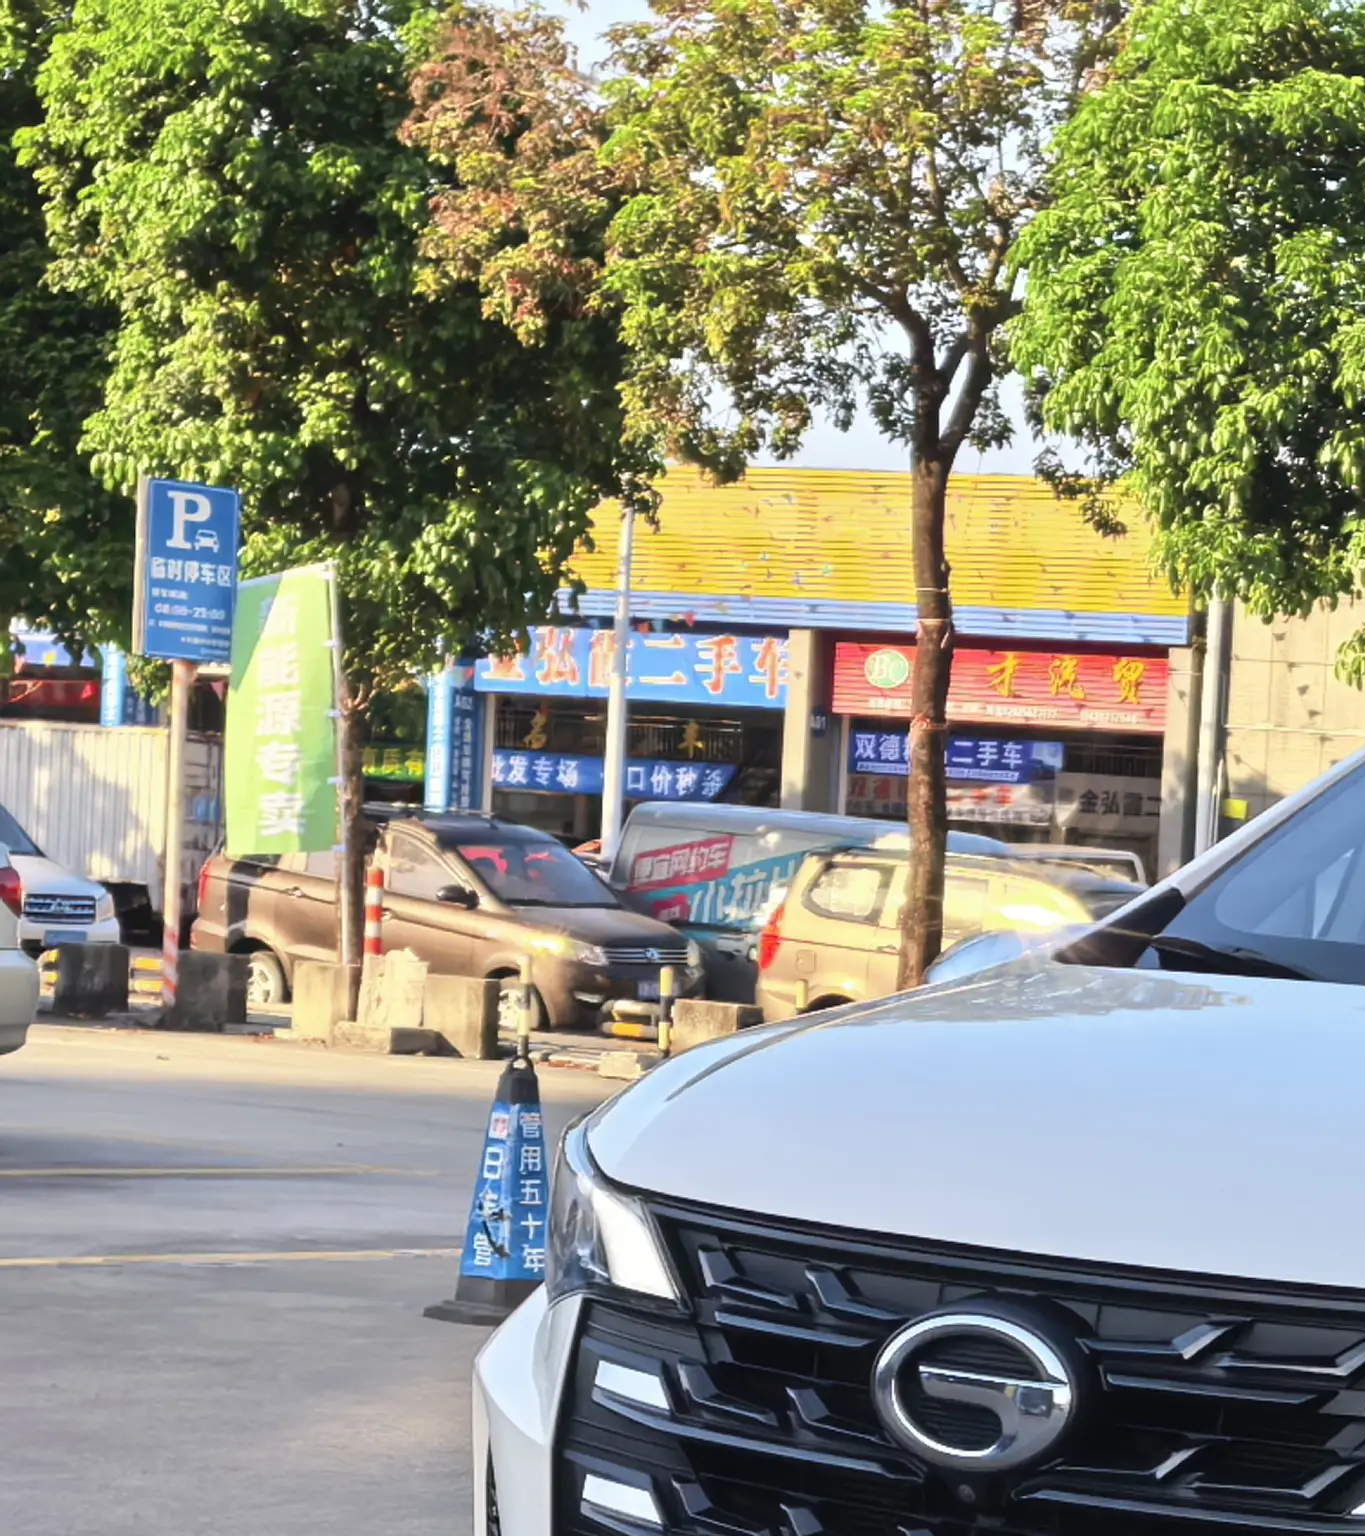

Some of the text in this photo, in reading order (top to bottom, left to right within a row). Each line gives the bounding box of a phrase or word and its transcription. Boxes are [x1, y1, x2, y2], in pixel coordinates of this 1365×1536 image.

[166, 490, 212, 550] P
[151, 556, 232, 588] 临时停车区
[257, 594, 306, 837] 新能源专卖
[854, 733, 1023, 768] 双德二手车
